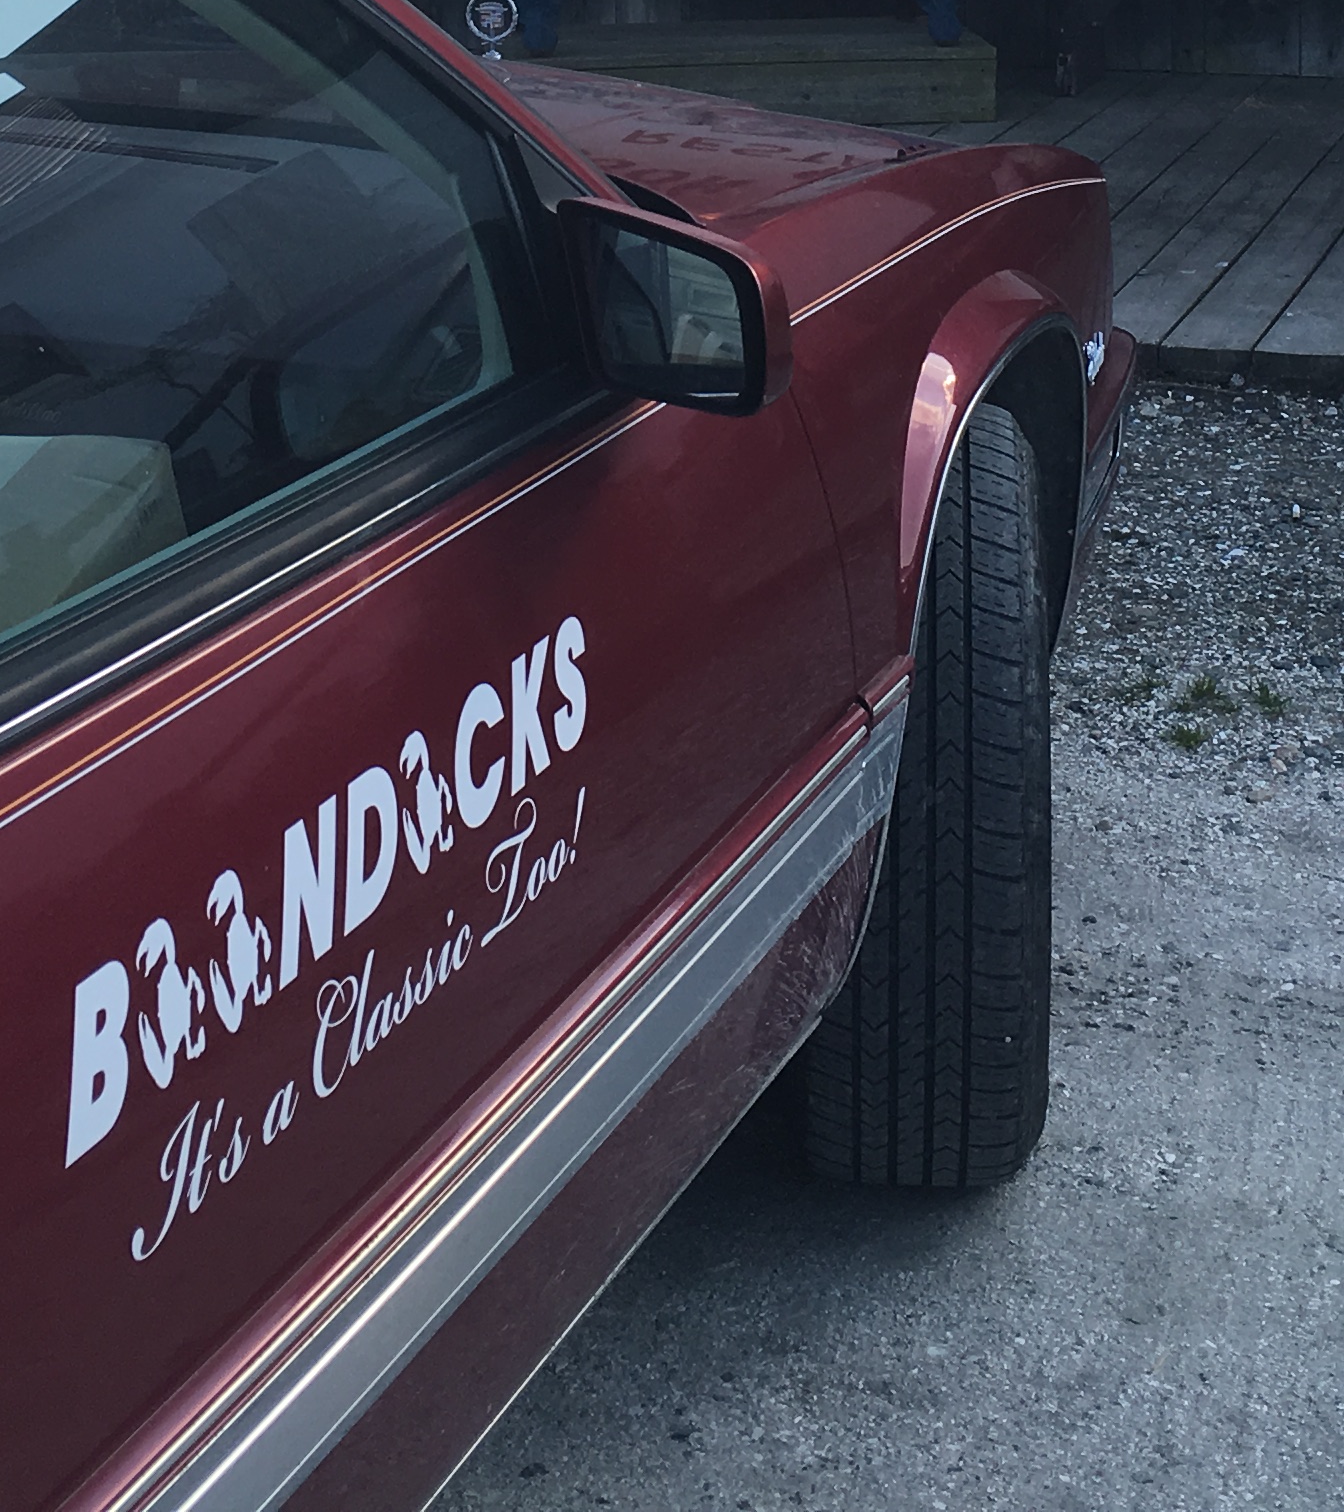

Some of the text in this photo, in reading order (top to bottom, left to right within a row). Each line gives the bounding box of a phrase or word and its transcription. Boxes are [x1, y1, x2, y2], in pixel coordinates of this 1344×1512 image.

[131, 786, 586, 1260] It's a Classic Too!
